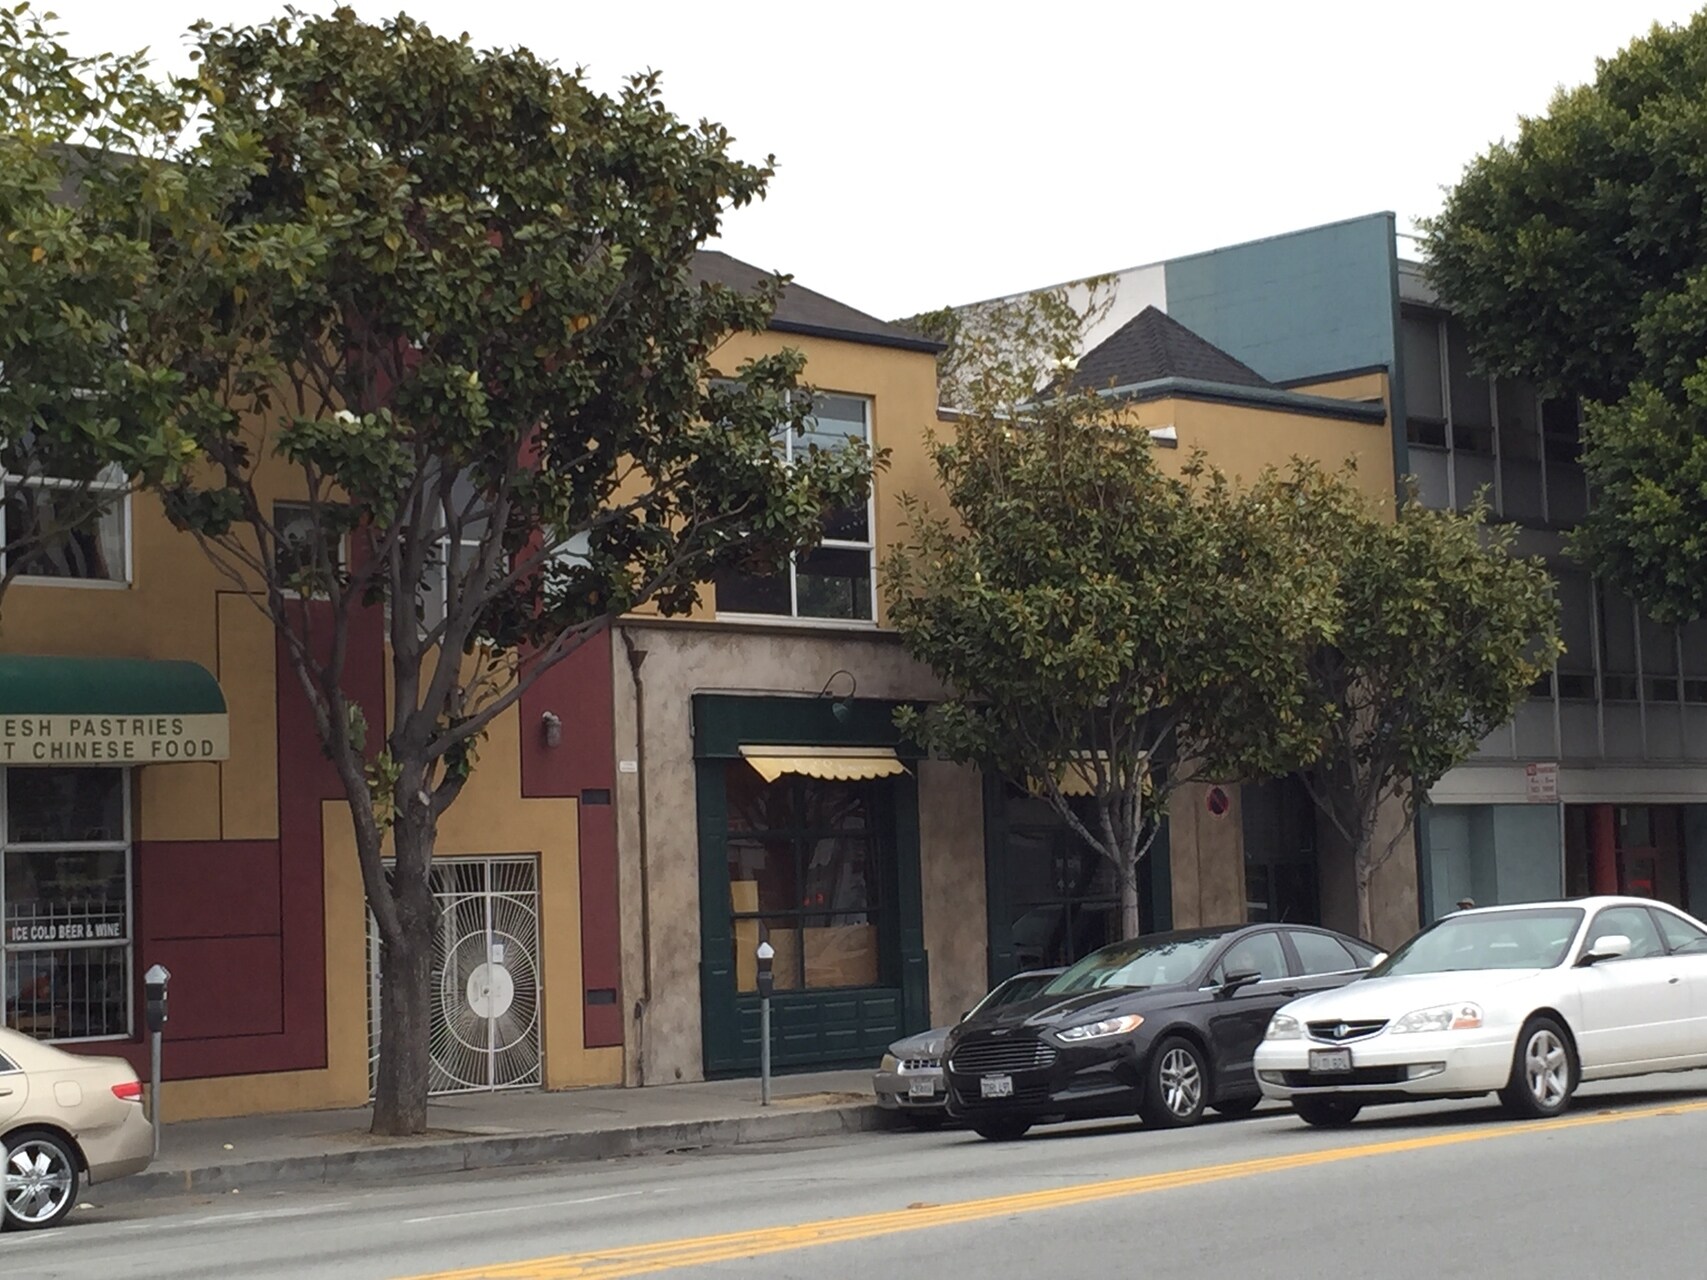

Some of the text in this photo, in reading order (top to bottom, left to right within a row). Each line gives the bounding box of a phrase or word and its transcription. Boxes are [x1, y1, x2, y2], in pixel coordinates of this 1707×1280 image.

[5, 718, 183, 737] ESH PASTRIES
[33, 740, 135, 759] CHINESE
[152, 739, 214, 757] FOOD
[12, 926, 28, 941] ICE
[30, 925, 57, 940] COLD
[58, 924, 84, 939] BEER
[95, 922, 120, 937] WINE
